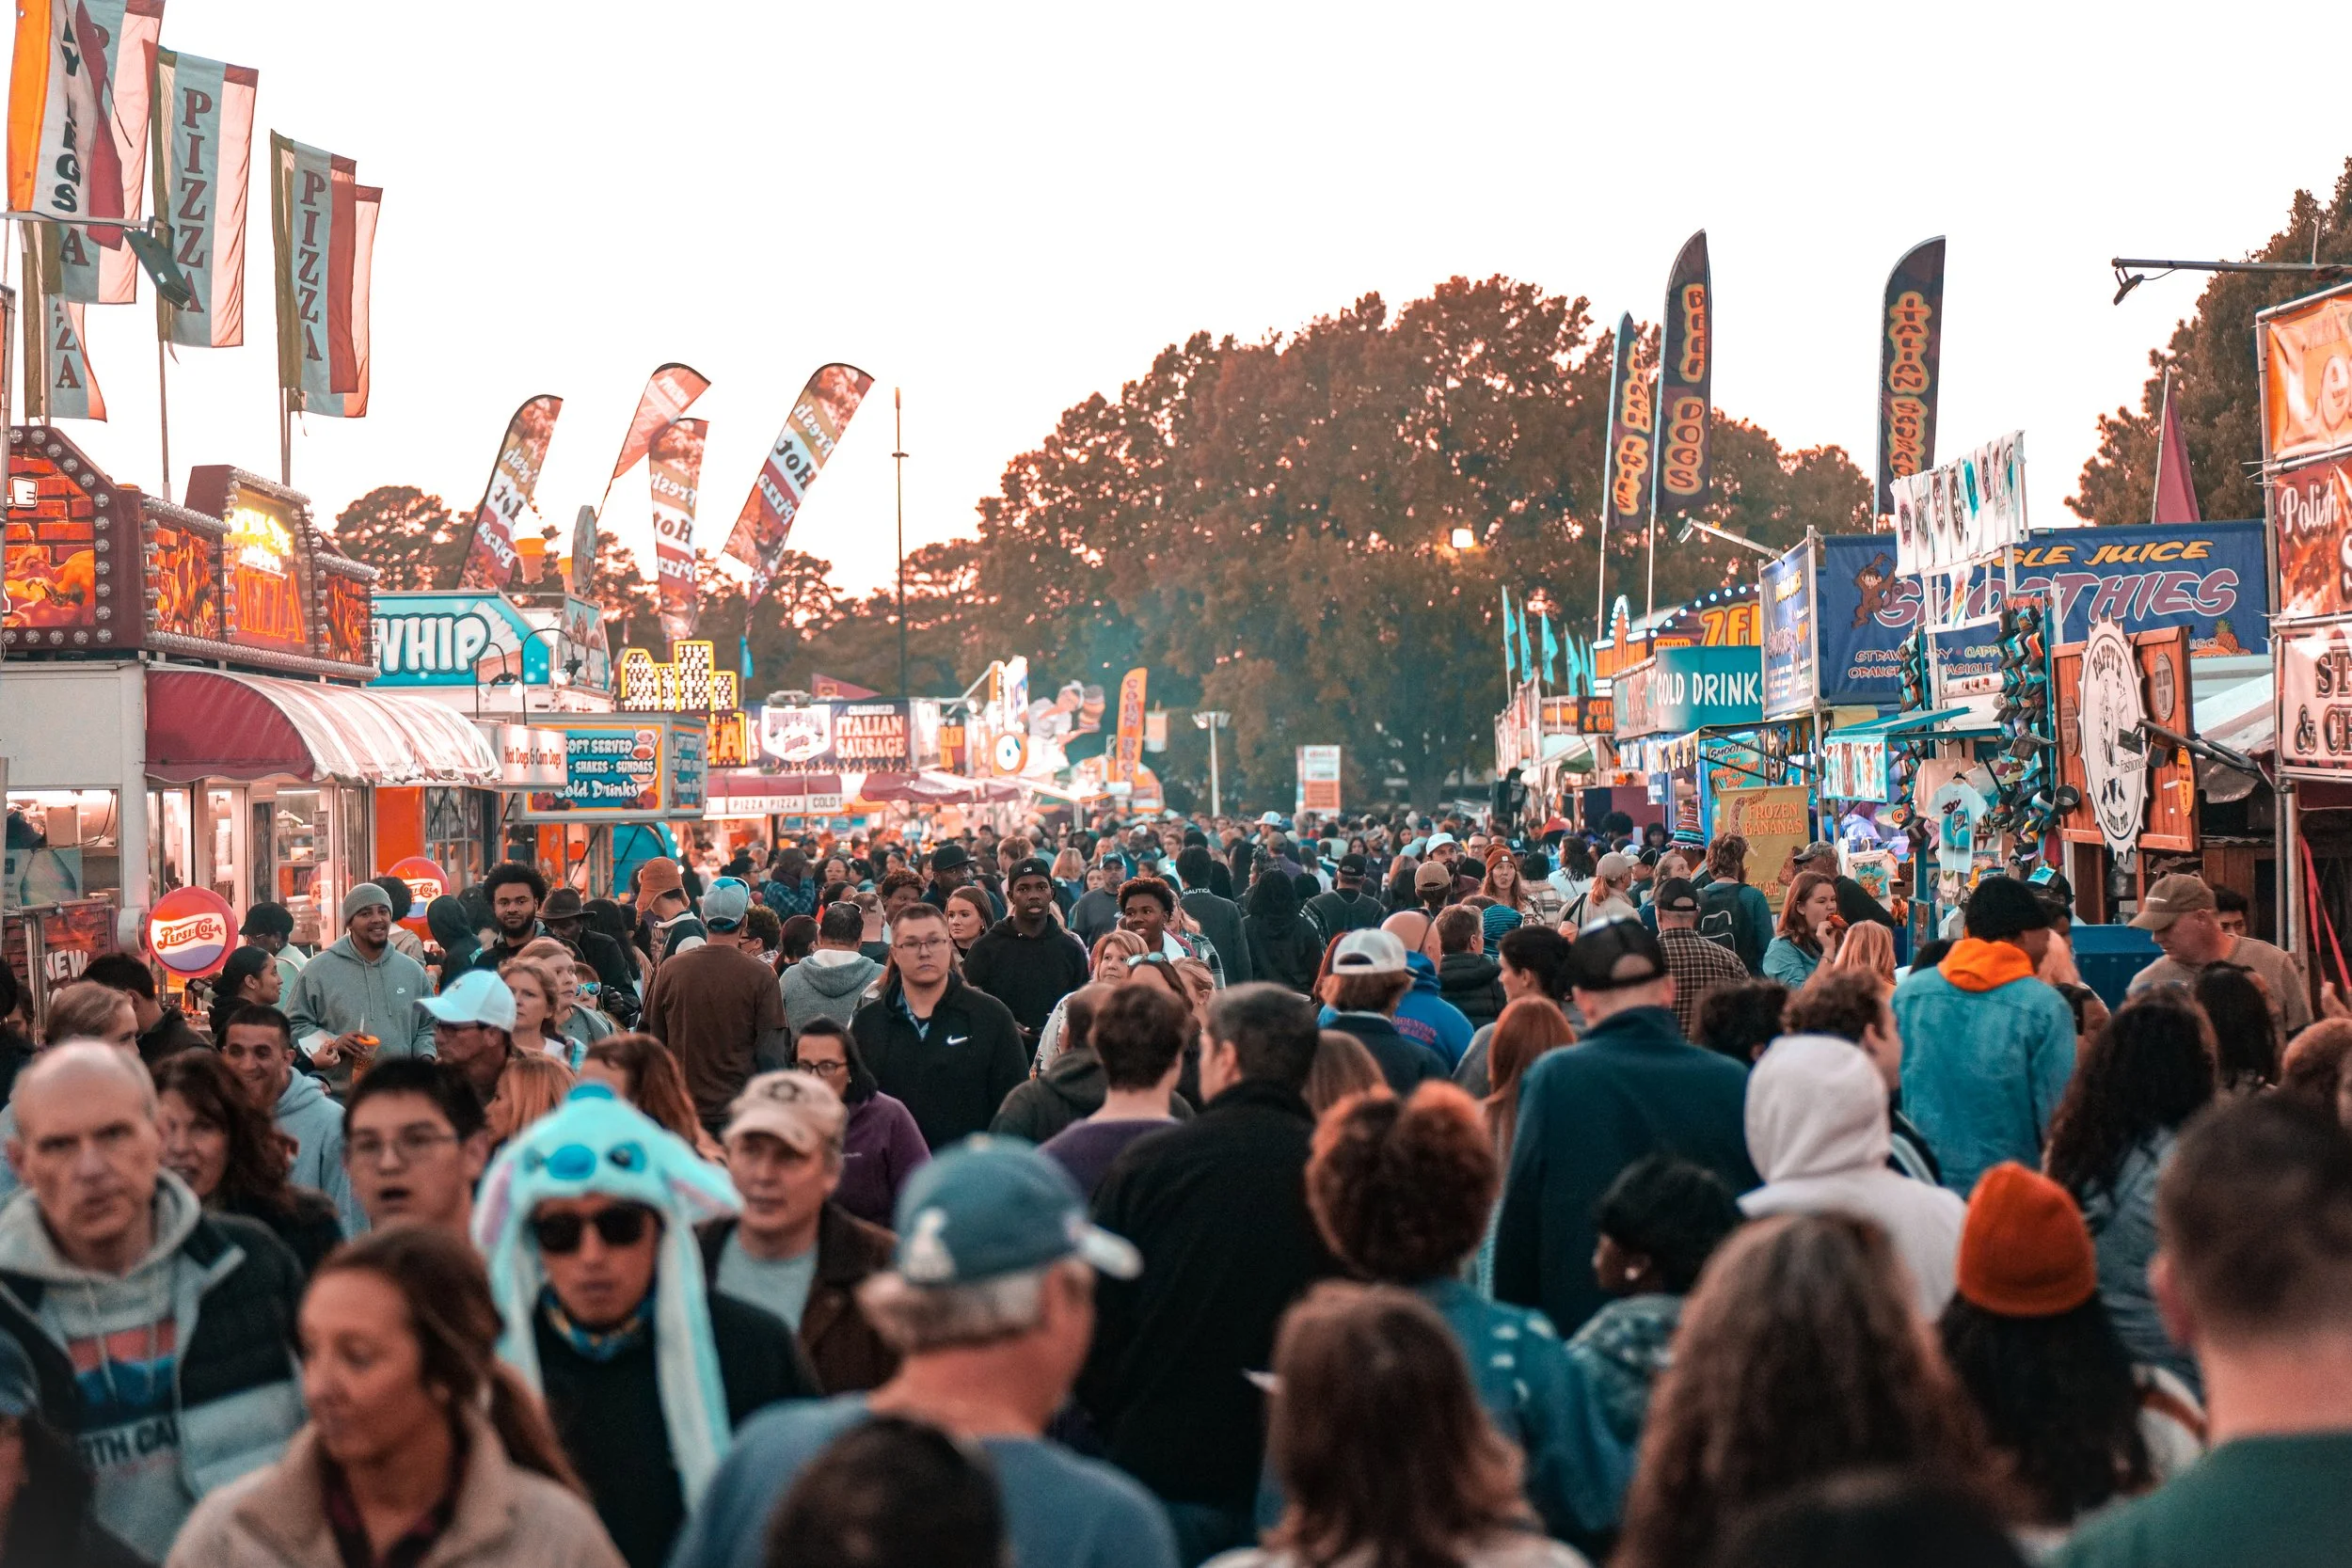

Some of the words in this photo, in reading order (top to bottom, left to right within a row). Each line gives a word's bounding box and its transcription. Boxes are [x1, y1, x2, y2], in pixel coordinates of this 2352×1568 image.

[178, 87, 213, 313] PIZZA
[298, 169, 327, 362] PIZZA
[1687, 288, 1706, 377] BEEF
[1668, 400, 1704, 489] DOGS
[2280, 481, 2341, 534] Polish
[2084, 540, 2214, 566] JUICE
[376, 613, 489, 674] WHIP
[1848, 665, 1900, 679] ORANGE
[2092, 643, 2123, 681] PAPPY'S
[2315, 646, 2352, 698] ST
[1657, 672, 1685, 705] COLD
[1692, 671, 1764, 706] DRINK
[836, 715, 904, 737] ITALIAN
[504, 745, 516, 765] Hot
[516, 748, 529, 769] Dogs
[535, 748, 548, 766] Corn
[548, 749, 562, 769] Dogs
[591, 737, 633, 754] SERVED
[834, 736, 907, 759] SAUSAGE
[575, 760, 609, 774] SHAKES
[615, 760, 655, 774] SUNDAES
[592, 780, 639, 799] Drinks
[734, 796, 763, 810] PIZZA
[770, 796, 799, 809] PIZZA
[813, 797, 837, 809] COLD
[1748, 802, 1799, 820] FROZEN
[1744, 819, 1804, 836] BANANAS
[1183, 888, 1211, 896] NAUTICA
